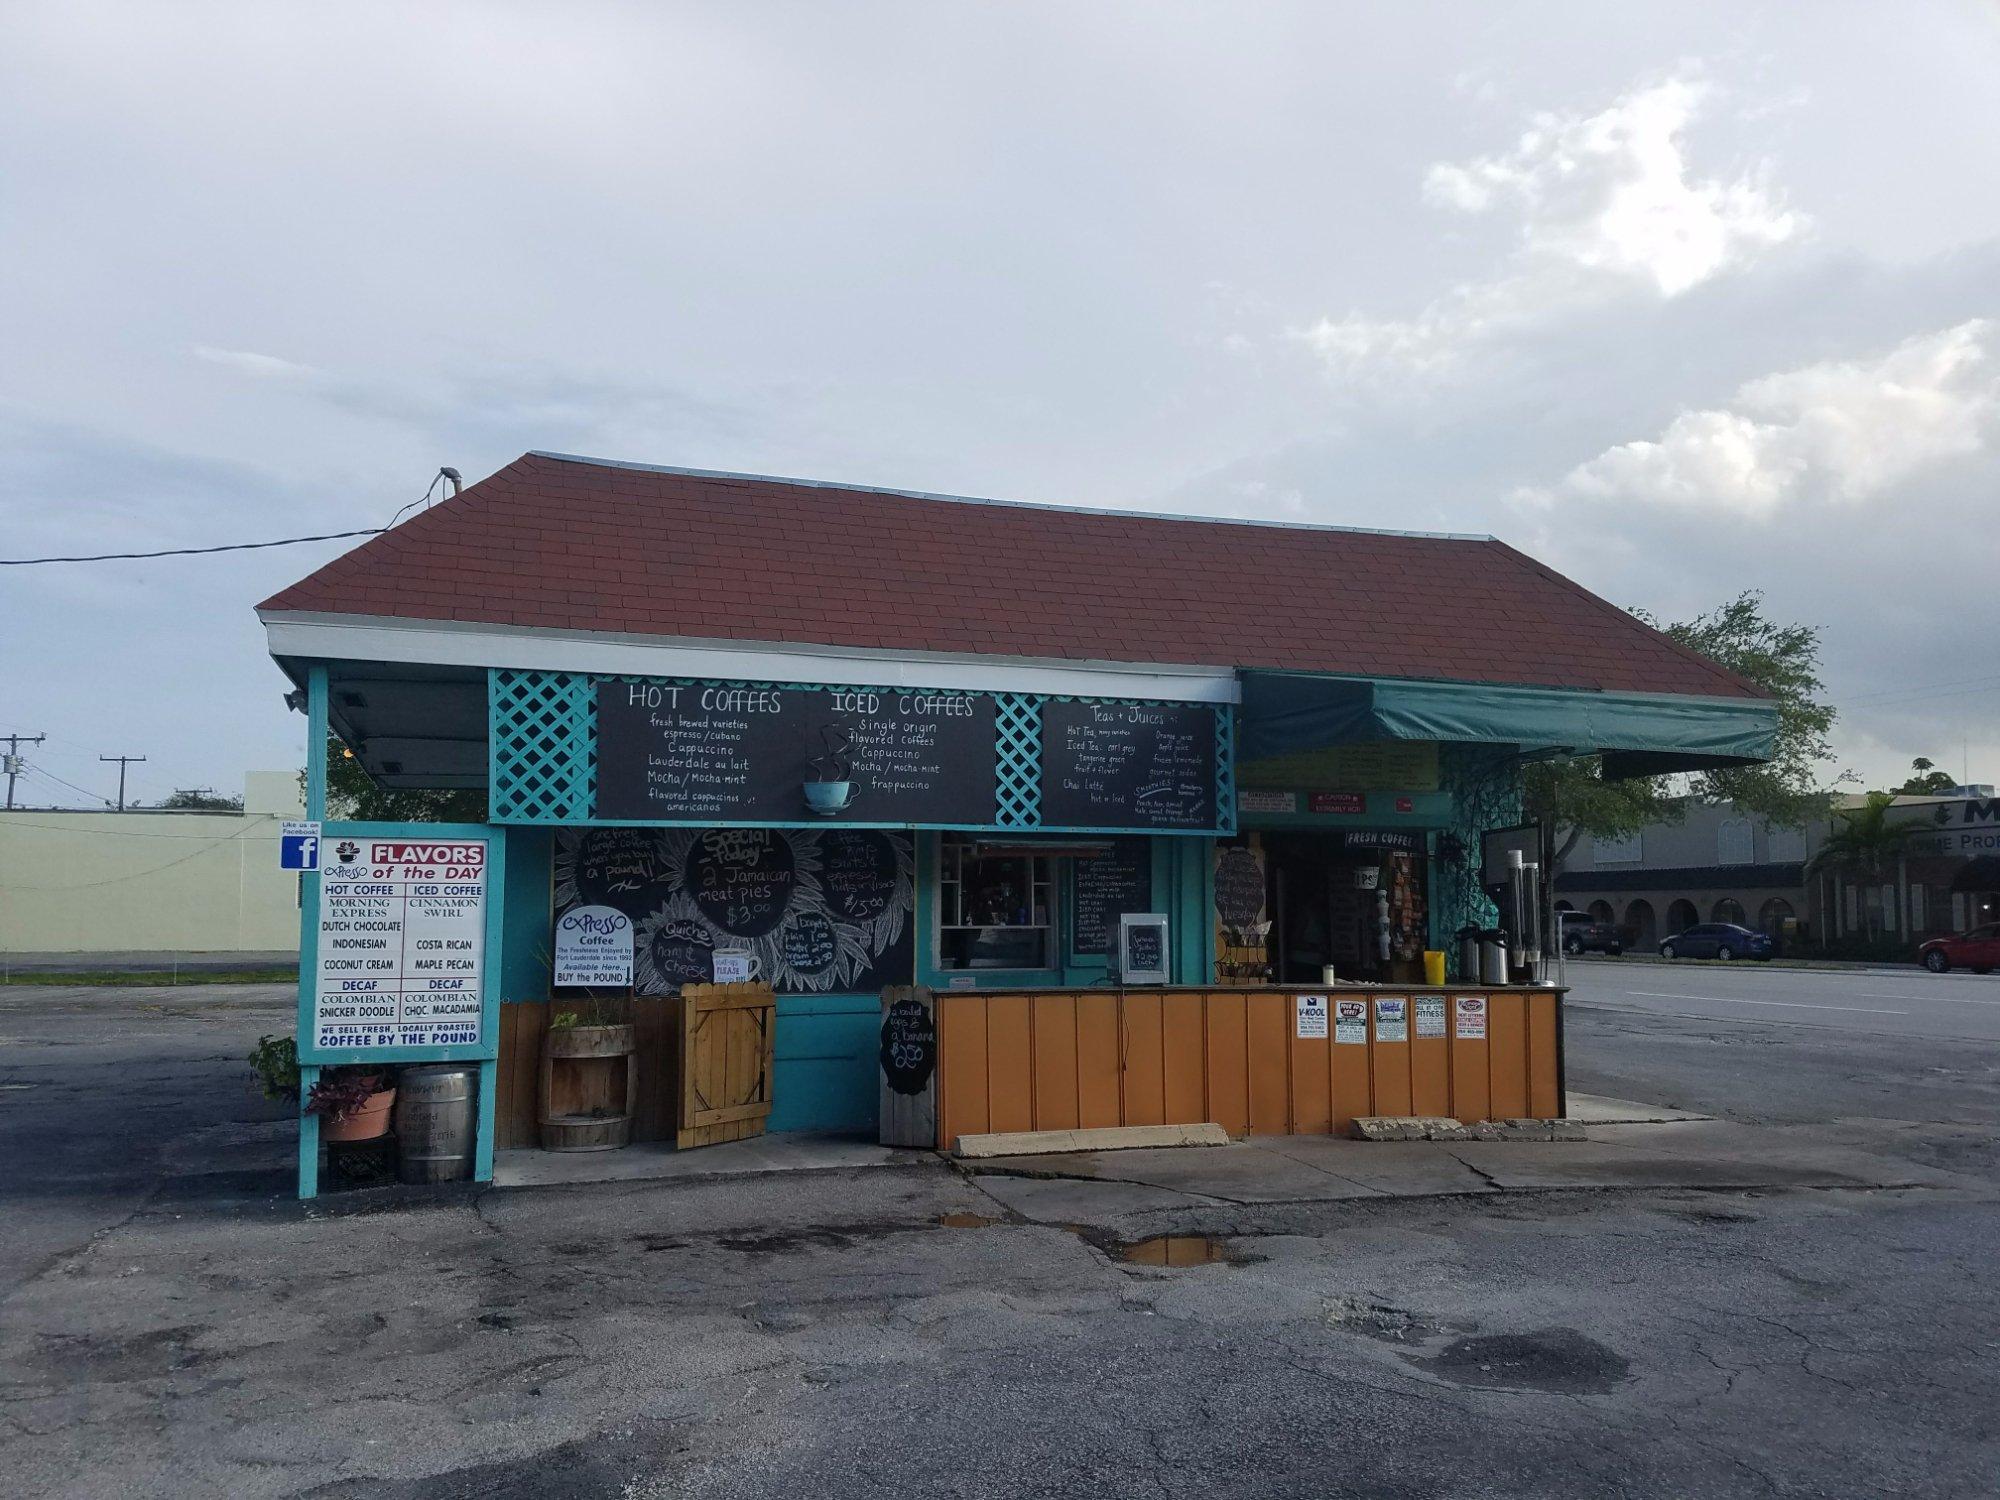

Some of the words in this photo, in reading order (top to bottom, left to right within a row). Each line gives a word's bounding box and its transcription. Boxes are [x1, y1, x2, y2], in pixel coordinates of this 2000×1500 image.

[630, 685, 684, 709] HOT
[701, 688, 781, 713] COFFEES
[831, 692, 880, 714] ICED
[900, 695, 974, 716] COFFEES
[1089, 705, 1114, 722] Teas
[650, 713, 673, 726] fresh
[679, 714, 709, 728] brewed
[712, 719, 749, 729] varieties
[859, 718, 897, 736] Single
[849, 732, 894, 744] flavored
[668, 741, 733, 757] Cappuccino
[861, 746, 920, 760] Cappuccino
[731, 758, 751, 771] lait
[852, 761, 881, 772] Mocha
[648, 771, 681, 785] Mocha
[872, 776, 930, 794] frappuccino
[649, 787, 689, 801] flavored
[1347, 831, 1379, 845] FRESH
[1381, 832, 1413, 847] COFFEE
[374, 846, 482, 863] FLAVORS
[372, 865, 395, 879] of
[403, 866, 436, 879] the
[445, 867, 483, 879] DAY
[724, 866, 791, 884] Jamaican
[325, 885, 352, 895] HOT
[354, 885, 394, 895] COFFEE
[414, 886, 439, 896] ICED
[443, 886, 483, 896] COFFEE
[698, 886, 735, 902] meat
[737, 885, 772, 904] pies
[329, 899, 391, 908] MORNING
[409, 899, 479, 908] CINNAMON
[332, 909, 387, 918] EXPRESS
[424, 909, 464, 918] SWIRL
[322, 922, 350, 931] DUTCH
[354, 922, 401, 932] CHOCOLATE
[665, 922, 711, 941] Quiche
[333, 939, 387, 949] INDONESIAN
[416, 940, 443, 950] COSTA
[446, 940, 472, 950] RICAN
[580, 936, 614, 945] Coffee
[625, 947, 632, 955] by
[324, 960, 363, 970] COCONUT
[366, 960, 394, 970] CREAM
[415, 960, 443, 970] MAPLE
[446, 960, 474, 970] PECAN
[557, 973, 573, 981] BUY
[577, 972, 590, 981] the
[594, 973, 623, 982] POUND
[342, 981, 378, 991] DECAF
[429, 980, 464, 990] DECAF
[321, 995, 396, 1004] COLOMBIAN
[404, 993, 477, 1002] COLOMBIAN
[319, 1008, 356, 1018] SNICKER
[360, 1007, 395, 1017] DOODLE
[405, 1006, 430, 1016] CHOC.
[433, 1004, 480, 1014] MACADAMIA
[1298, 1008, 1326, 1016] V-KOOL
[1416, 1010, 1445, 1018] FITNESS
[338, 1026, 359, 1034] SELL
[398, 1024, 434, 1032] LOCALLY
[437, 1024, 476, 1032] ROASTED
[319, 1036, 373, 1046] COFFEE
[378, 1035, 395, 1045] BY
[400, 1034, 426, 1044] THE
[432, 1033, 477, 1043] POUND
